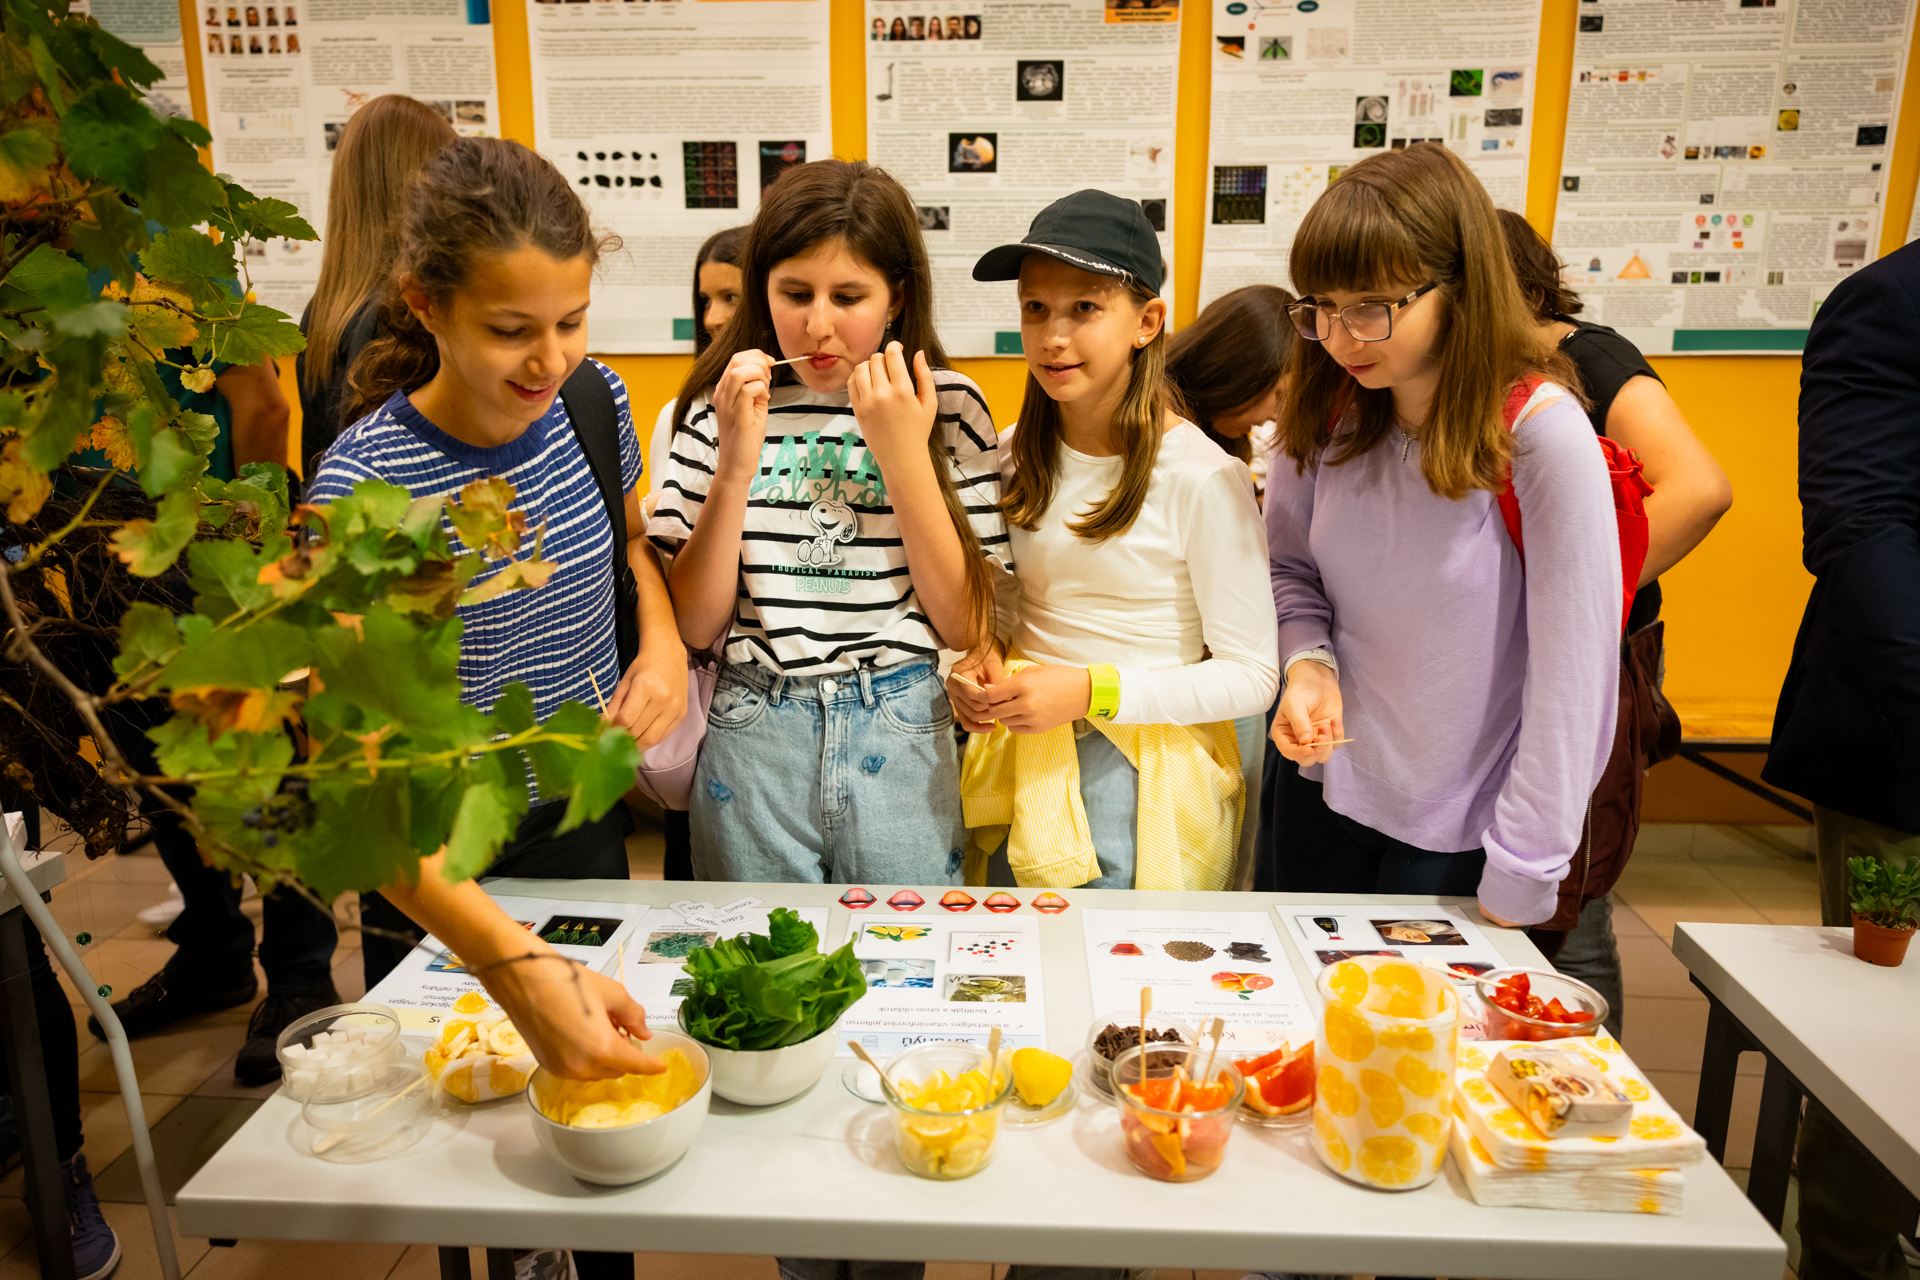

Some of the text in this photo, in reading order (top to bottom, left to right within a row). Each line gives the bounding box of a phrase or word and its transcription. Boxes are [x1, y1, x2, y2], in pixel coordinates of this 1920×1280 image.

[750, 430, 889, 497] AWA
[766, 456, 885, 508] aloha
[795, 576, 851, 594] PEANUTS
[724, 900, 753, 914] Keserű
[845, 1019, 881, 1027] jellemzi
[902, 1035, 976, 1047] aanyú
